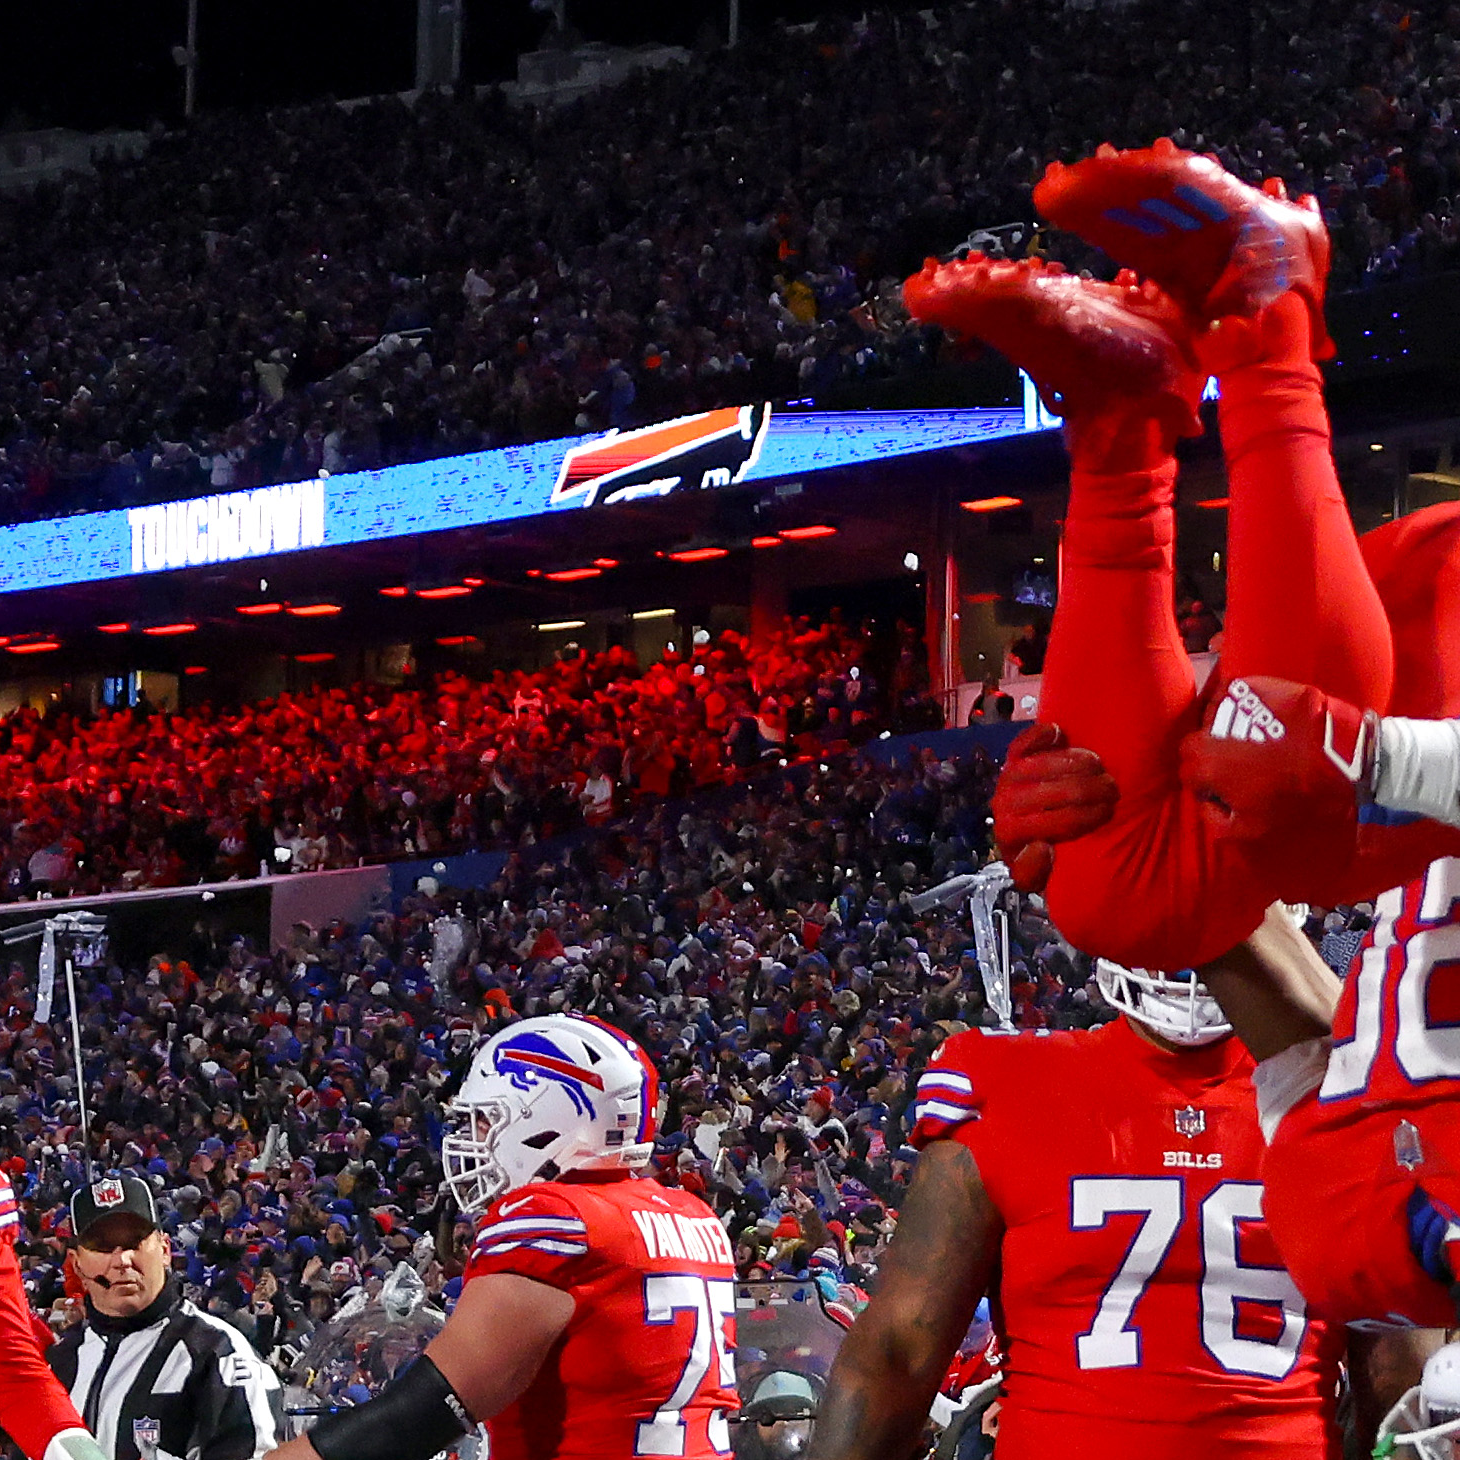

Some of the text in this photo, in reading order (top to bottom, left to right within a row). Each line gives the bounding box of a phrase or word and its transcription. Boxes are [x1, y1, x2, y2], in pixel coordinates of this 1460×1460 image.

[128, 478, 326, 573] TOUCHDOWN
[1163, 1151, 1223, 1169] BILLS
[1069, 1175, 1309, 1381] 76
[633, 1271, 737, 1457] 75
